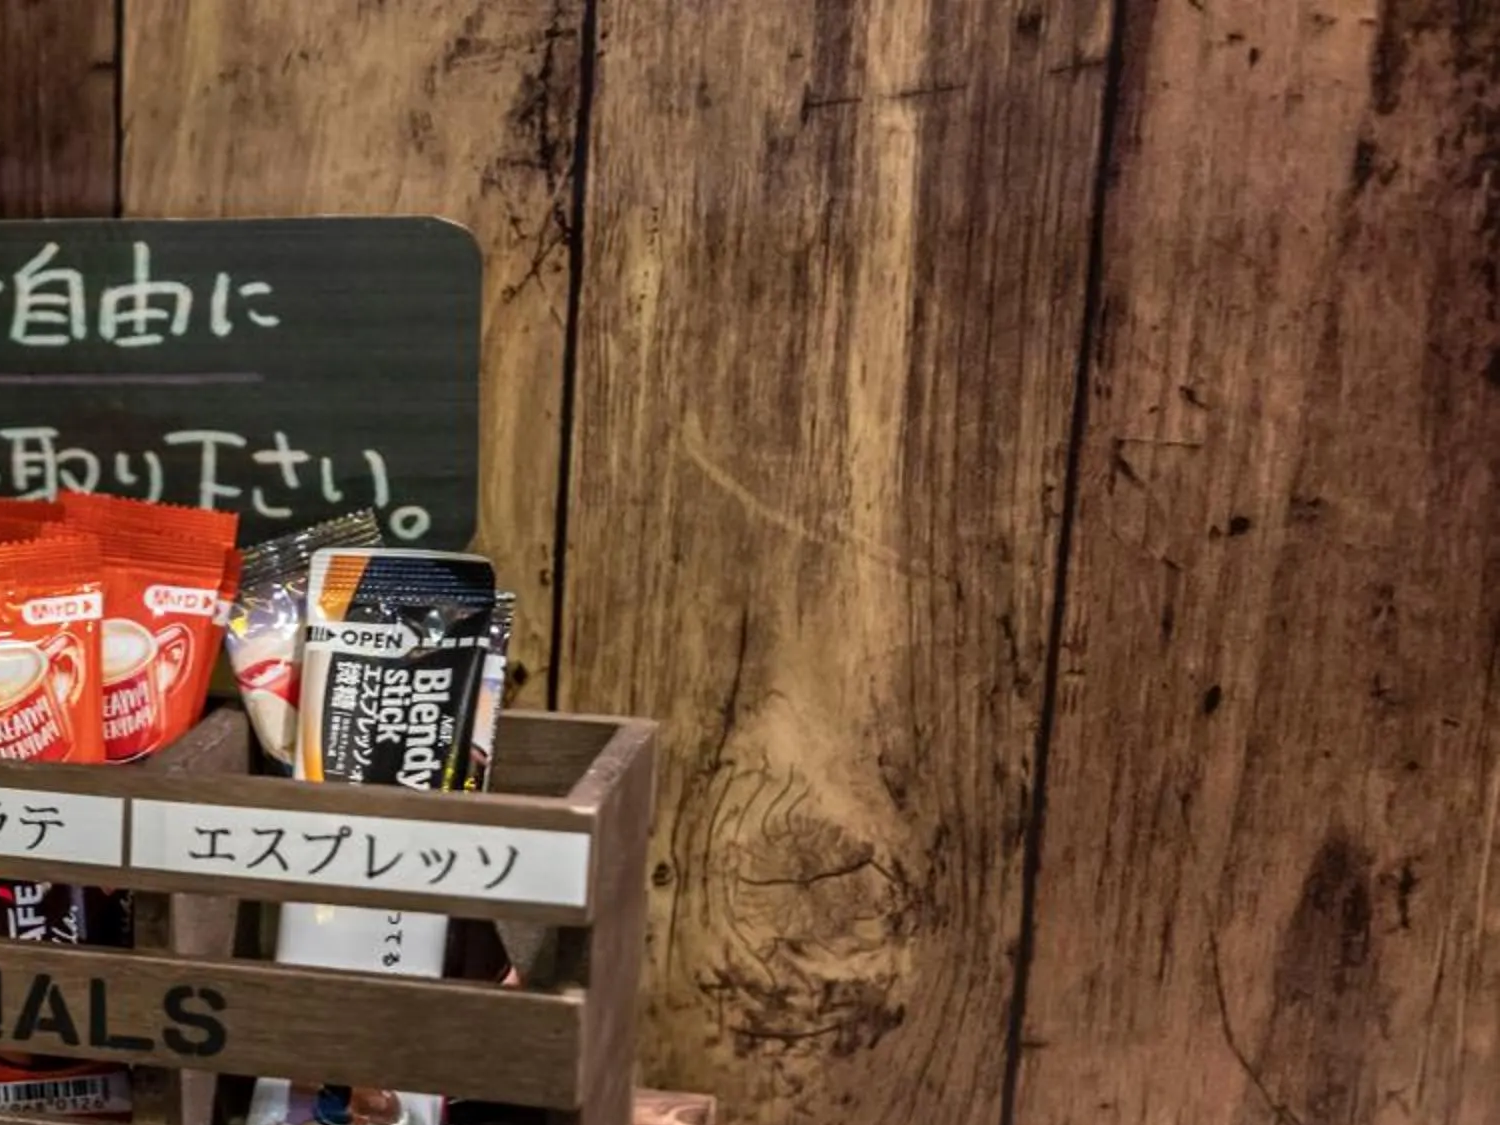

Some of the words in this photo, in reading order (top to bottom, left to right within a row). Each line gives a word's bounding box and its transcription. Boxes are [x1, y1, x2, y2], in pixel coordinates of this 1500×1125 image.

[340, 629, 404, 650] OPEN
[375, 668, 413, 744] stick
[395, 667, 453, 791] Blendy
[187, 824, 521, 890] エスプレッソ
